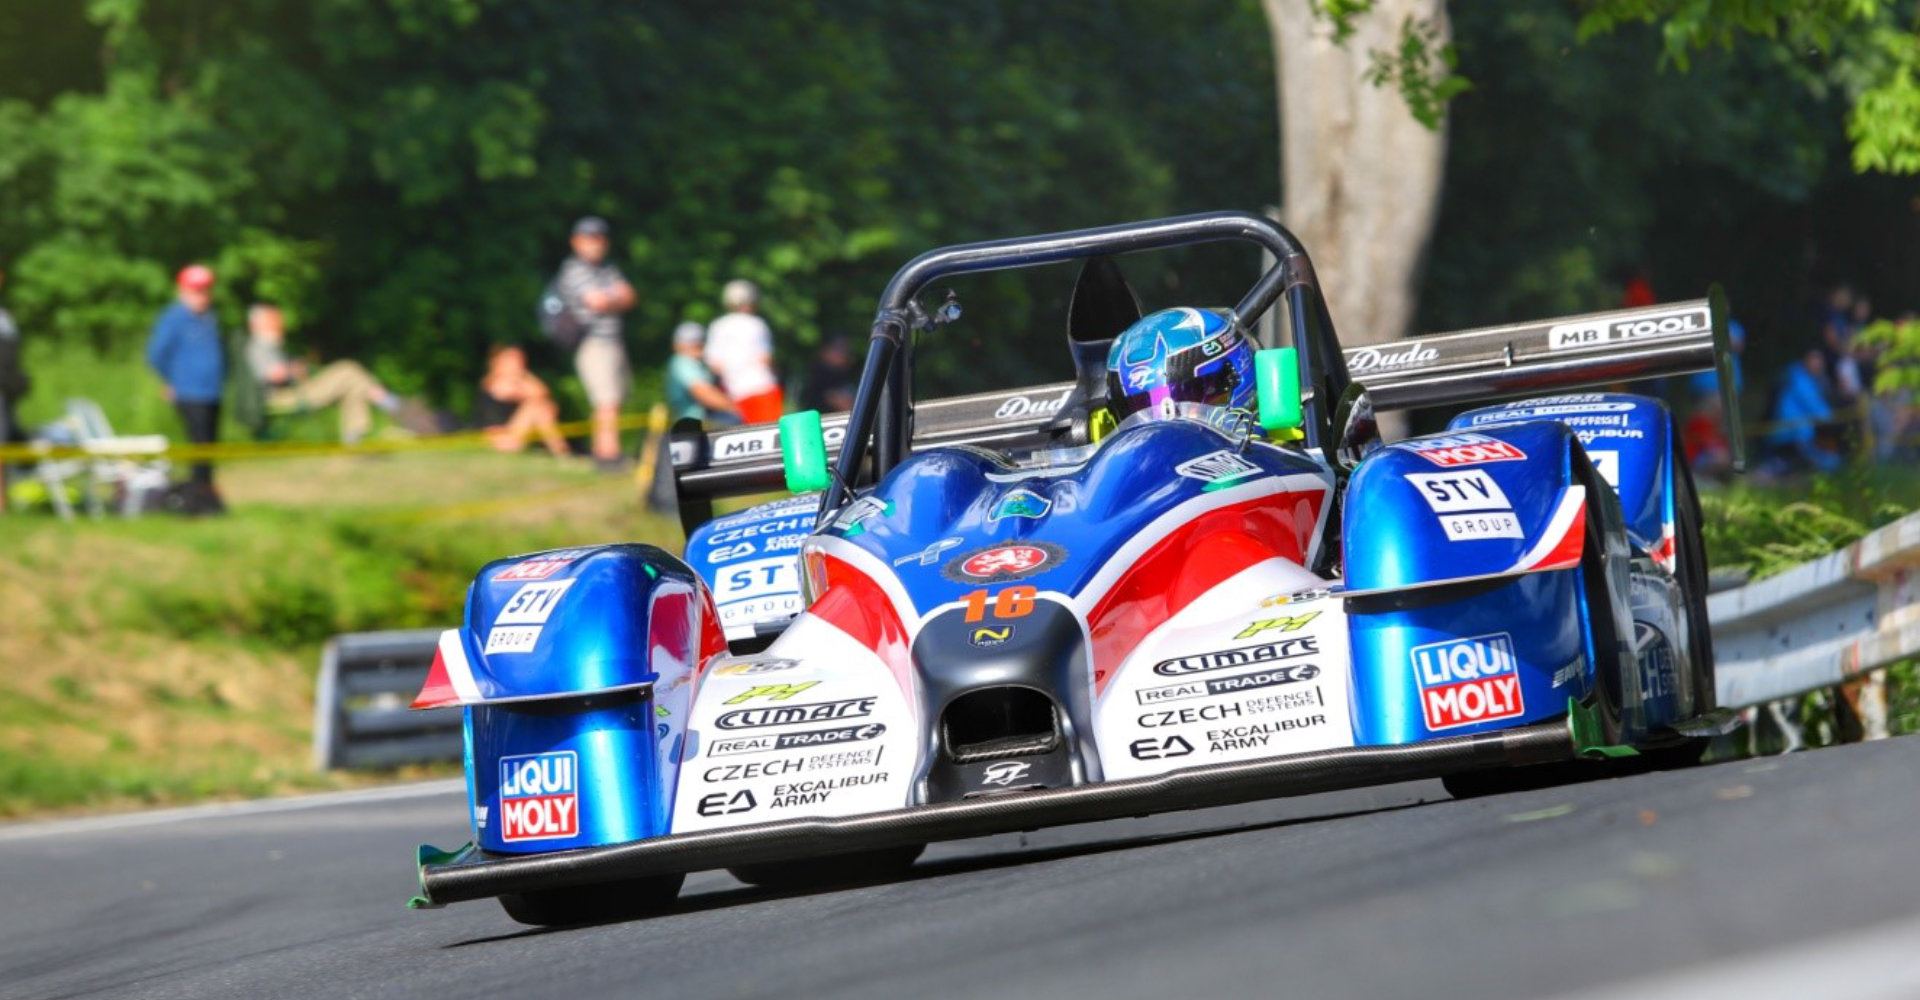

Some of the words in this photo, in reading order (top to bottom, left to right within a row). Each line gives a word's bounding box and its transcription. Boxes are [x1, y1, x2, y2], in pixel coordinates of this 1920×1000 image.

[1559, 330, 1599, 346] MB
[1616, 315, 1699, 339] TOOL
[1347, 342, 1439, 372] Duda
[995, 390, 1072, 419] Dud
[725, 440, 763, 455] MB
[1423, 442, 1516, 464] MOLY
[1425, 477, 1490, 502] STV
[707, 518, 798, 546] CZECH
[1452, 518, 1513, 534] GROUP
[729, 564, 798, 592] ST
[508, 587, 562, 614] STV
[725, 600, 795, 619] GROU
[959, 585, 1038, 623] 16
[491, 632, 533, 647] GROUP
[1420, 639, 1512, 684] LIQUI
[1144, 685, 1203, 701] REAL
[1211, 671, 1286, 691] TRADE
[1137, 702, 1242, 728] CZECH
[1246, 690, 1313, 708] DEFENCE
[1248, 698, 1315, 715] SYSTEMS
[1428, 677, 1517, 724] MOLY
[717, 739, 771, 752] REAL
[781, 729, 853, 746] TRADE
[1206, 714, 1327, 742] EXCALIBUR
[1209, 734, 1270, 753] ARMY
[503, 758, 571, 796] LIQUI
[703, 758, 805, 783] CZECH
[810, 749, 874, 763] DEFENCE
[808, 757, 872, 771] SYSTEMS
[773, 771, 889, 797] EXCALIBUR
[770, 790, 831, 809] ARMY
[504, 797, 574, 836] MOLY
